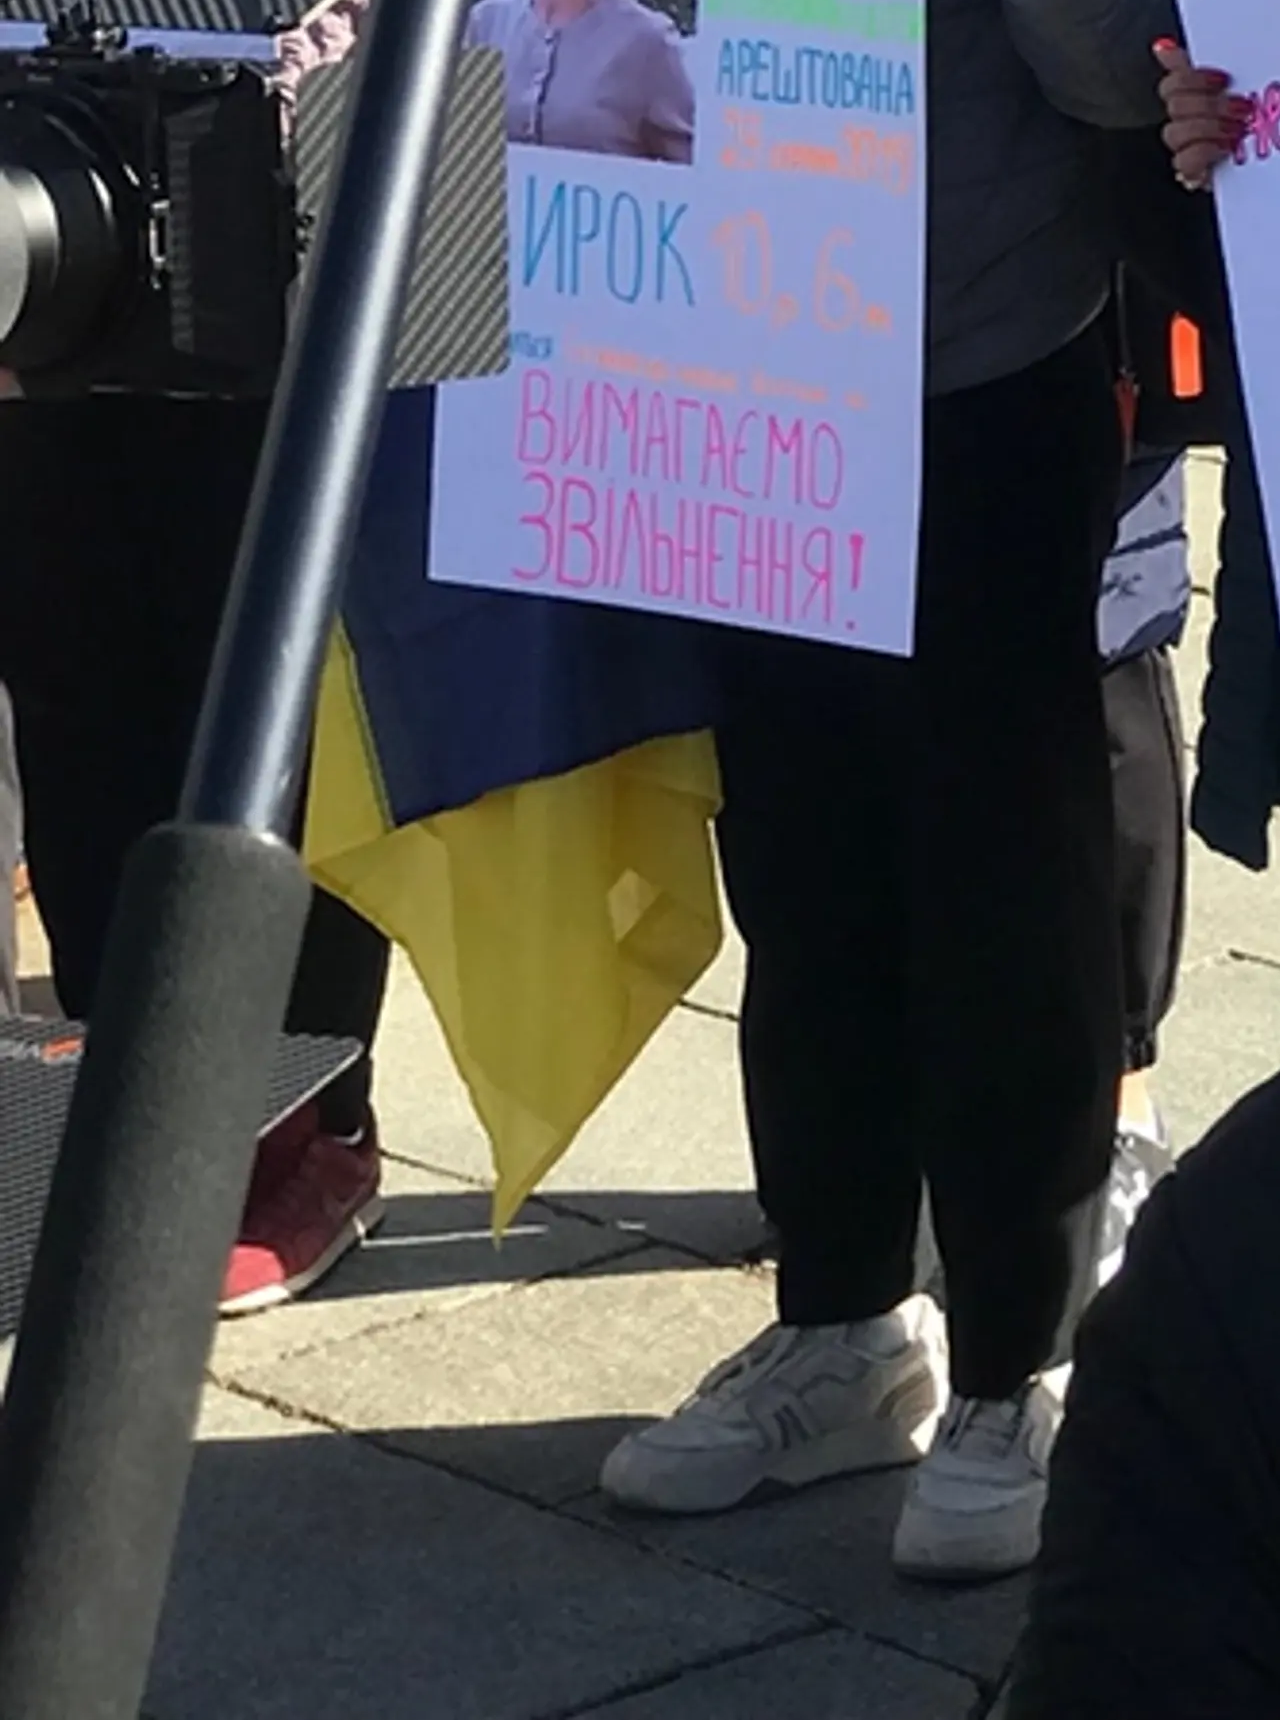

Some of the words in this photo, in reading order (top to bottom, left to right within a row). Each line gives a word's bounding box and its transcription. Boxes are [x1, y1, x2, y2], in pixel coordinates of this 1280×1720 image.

[716, 38, 916, 116] АРЕШТОВАНА
[523, 174, 696, 308] ИРОК
[517, 369, 843, 511] ВИМАГАЄМО
